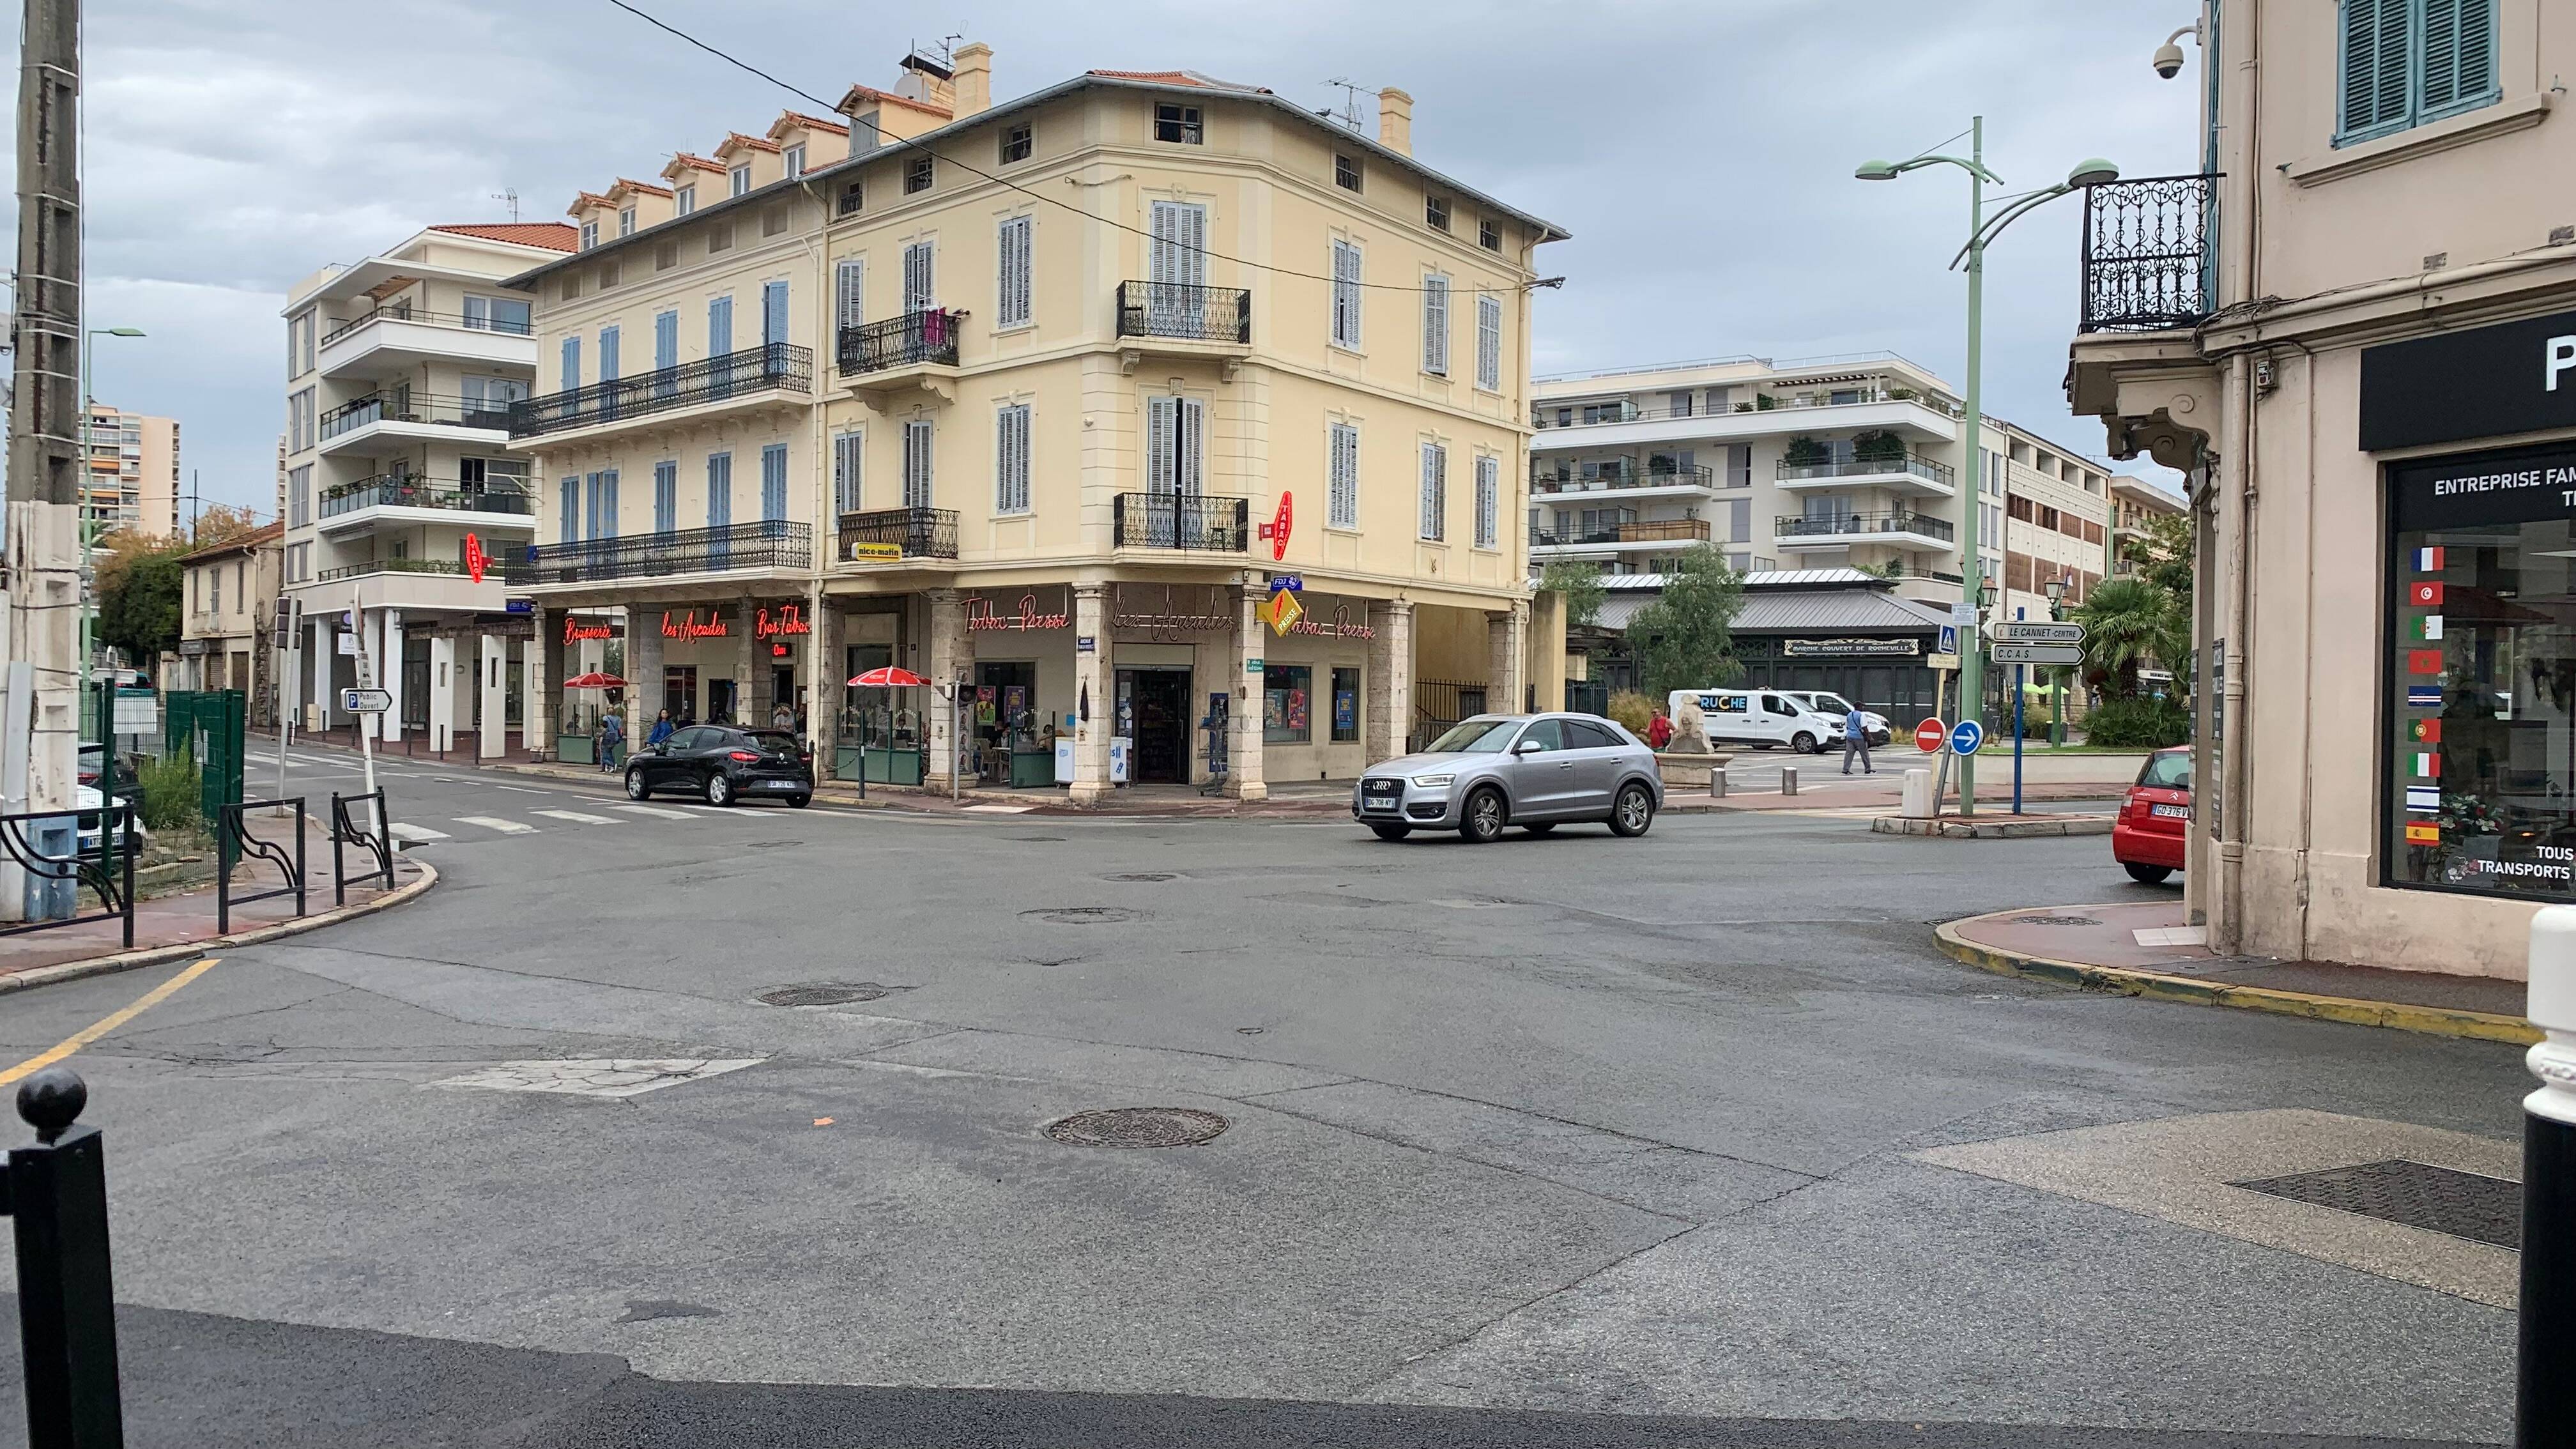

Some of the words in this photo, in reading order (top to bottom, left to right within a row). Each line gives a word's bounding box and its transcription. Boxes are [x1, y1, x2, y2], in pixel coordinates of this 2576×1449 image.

[2435, 470, 2540, 495] ENTREPRISE
[1278, 505, 1288, 546] TABAC
[470, 543, 479, 573] TABAC
[859, 547, 899, 556] nice-matin
[756, 609, 779, 640] Bar
[962, 597, 1008, 633] Tabac
[1019, 594, 1070, 632] Presse
[1151, 599, 1234, 641] Arcades
[1278, 608, 1297, 631] PRESSE
[1291, 606, 1326, 634] abac
[564, 617, 612, 646] Brasserie
[679, 611, 727, 644] Arcades
[2009, 628, 2018, 636] LE
[2020, 628, 2051, 637] CANNET
[1701, 696, 1746, 709] RUCHE
[2157, 806, 2188, 816] GD-376-V
[2536, 845, 2574, 861] TOUS
[2478, 859, 2570, 880] TRANSPORTS
